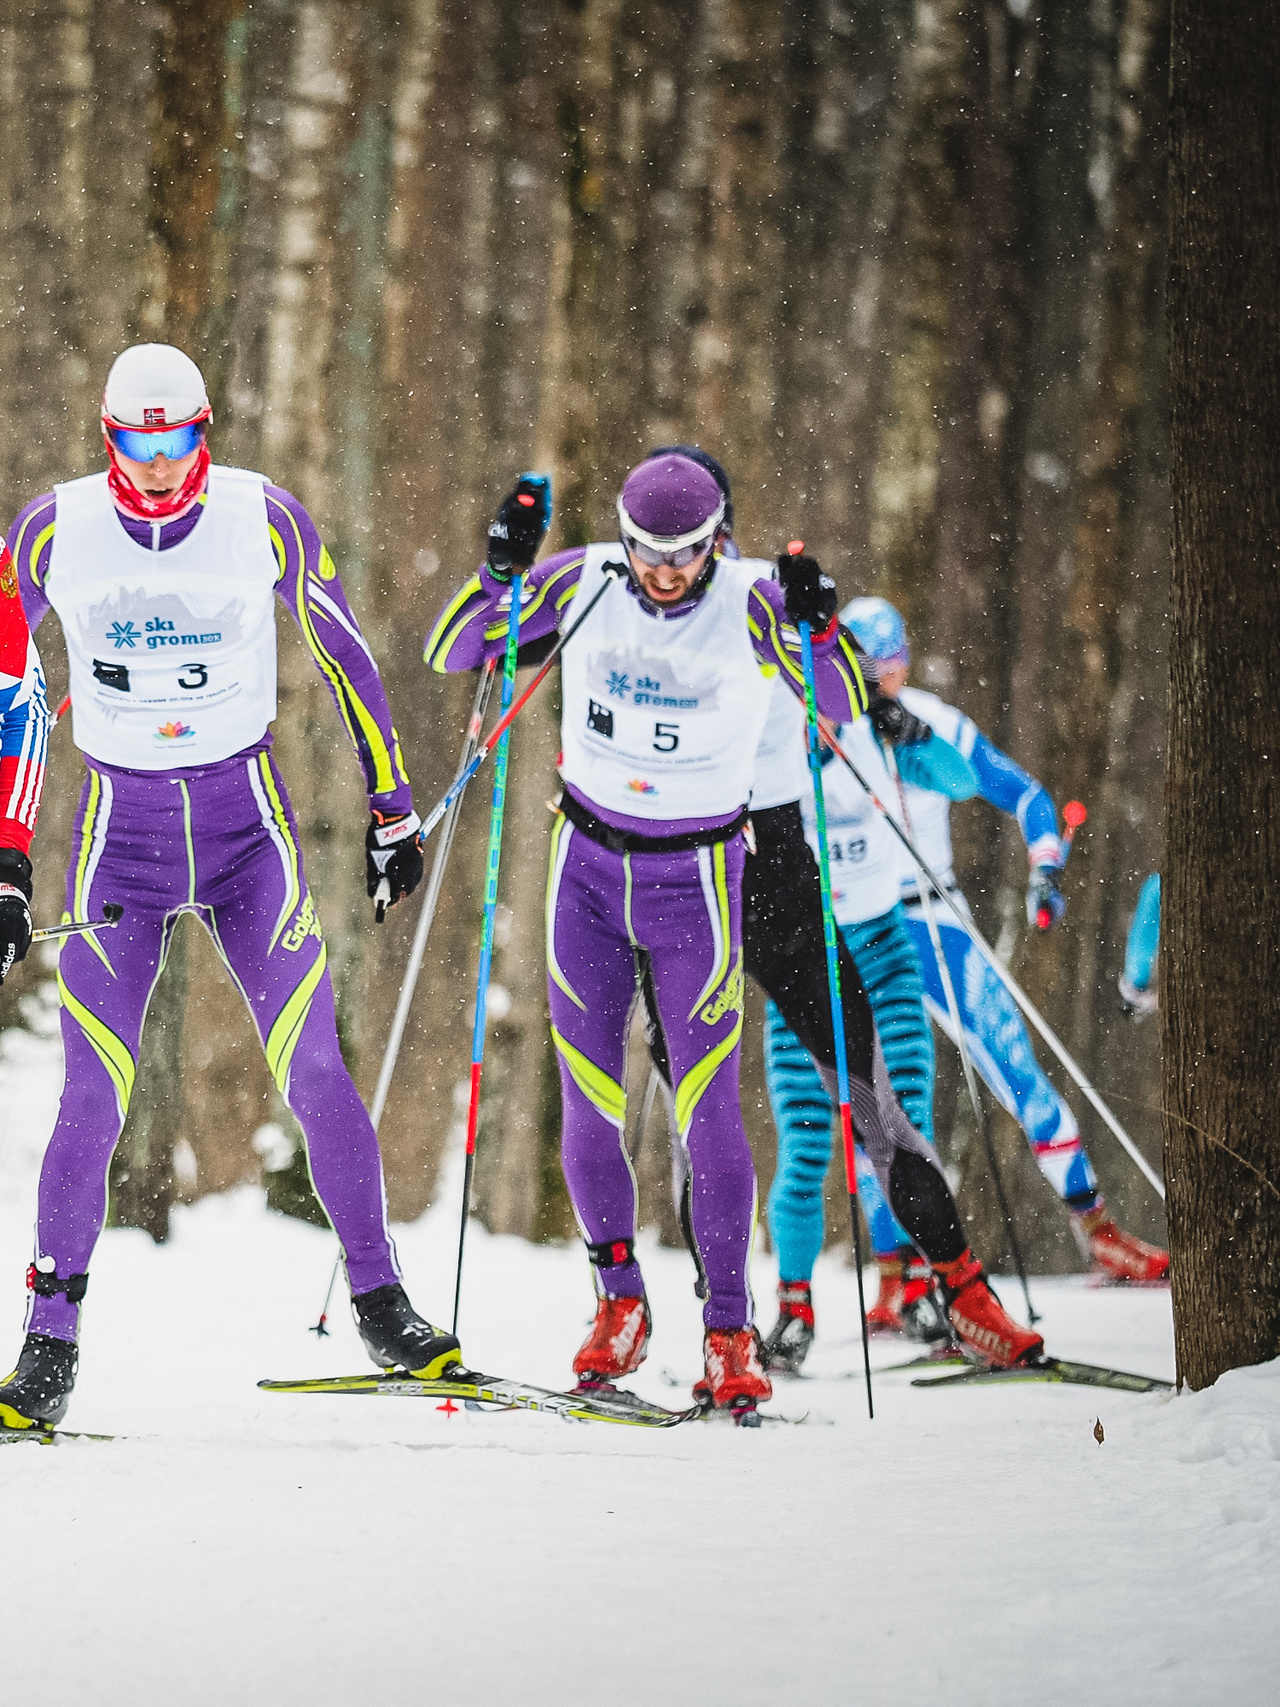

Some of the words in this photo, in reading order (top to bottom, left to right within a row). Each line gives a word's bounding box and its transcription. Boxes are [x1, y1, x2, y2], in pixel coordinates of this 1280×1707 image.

[145, 617, 175, 632] ski
[147, 635, 199, 649] grom
[178, 663, 208, 689] 3
[653, 722, 680, 752] 5
